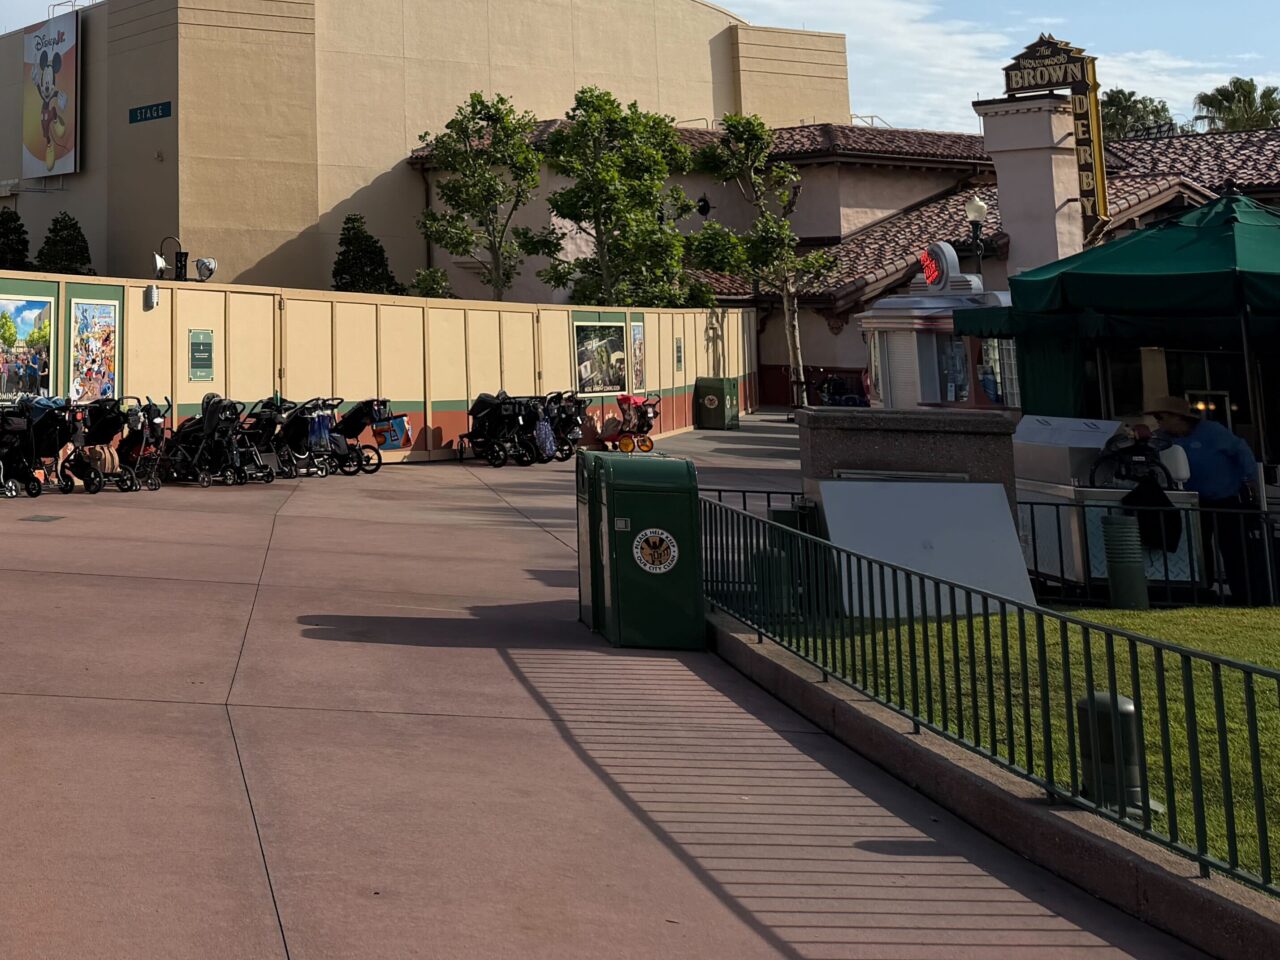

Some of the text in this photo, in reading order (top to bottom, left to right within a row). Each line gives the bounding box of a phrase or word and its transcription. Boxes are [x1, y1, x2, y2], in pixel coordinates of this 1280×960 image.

[1035, 45, 1053, 57] The
[1020, 51, 1068, 69] HOLLYWOOD
[1008, 62, 1082, 90] BROWN
[137, 105, 164, 121] STAGE
[1073, 94, 1096, 217] DERBY
[635, 532, 648, 549] PLEASE
[665, 535, 676, 549] KEEP
[637, 556, 647, 567] OUR
[663, 555, 675, 569] CLEAN
